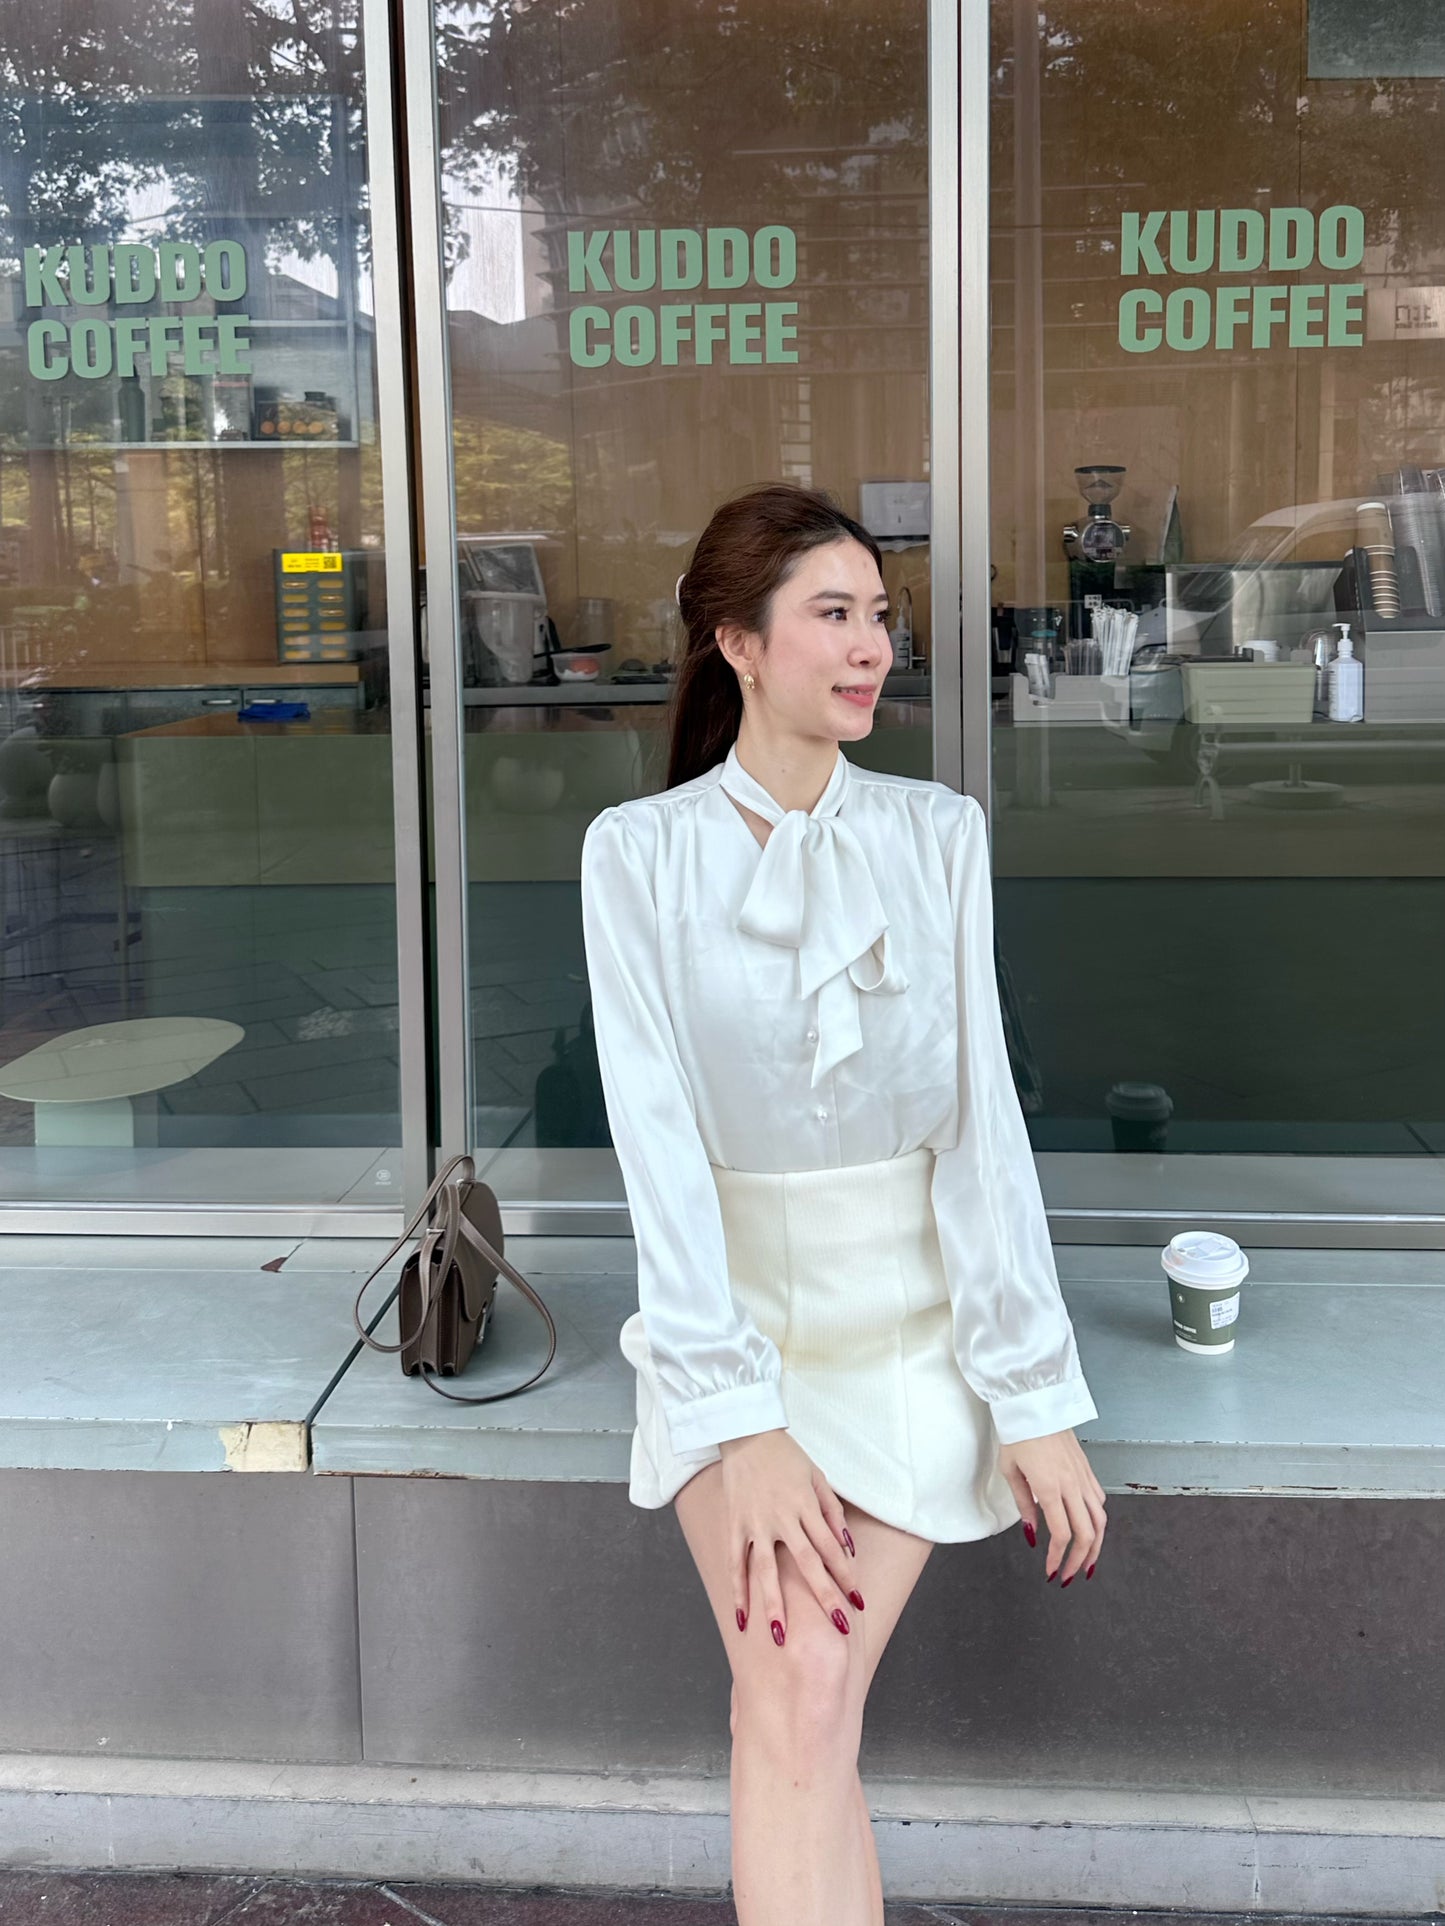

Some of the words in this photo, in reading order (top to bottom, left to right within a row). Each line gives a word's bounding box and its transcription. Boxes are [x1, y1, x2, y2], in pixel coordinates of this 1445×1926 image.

[24, 239, 247, 307] KUDDO
[567, 225, 797, 292] KUDDO
[1120, 205, 1365, 275] KUDDO
[27, 314, 252, 380] COFFEE
[569, 302, 799, 368] COFFEE
[1118, 284, 1364, 353] COFFEE
